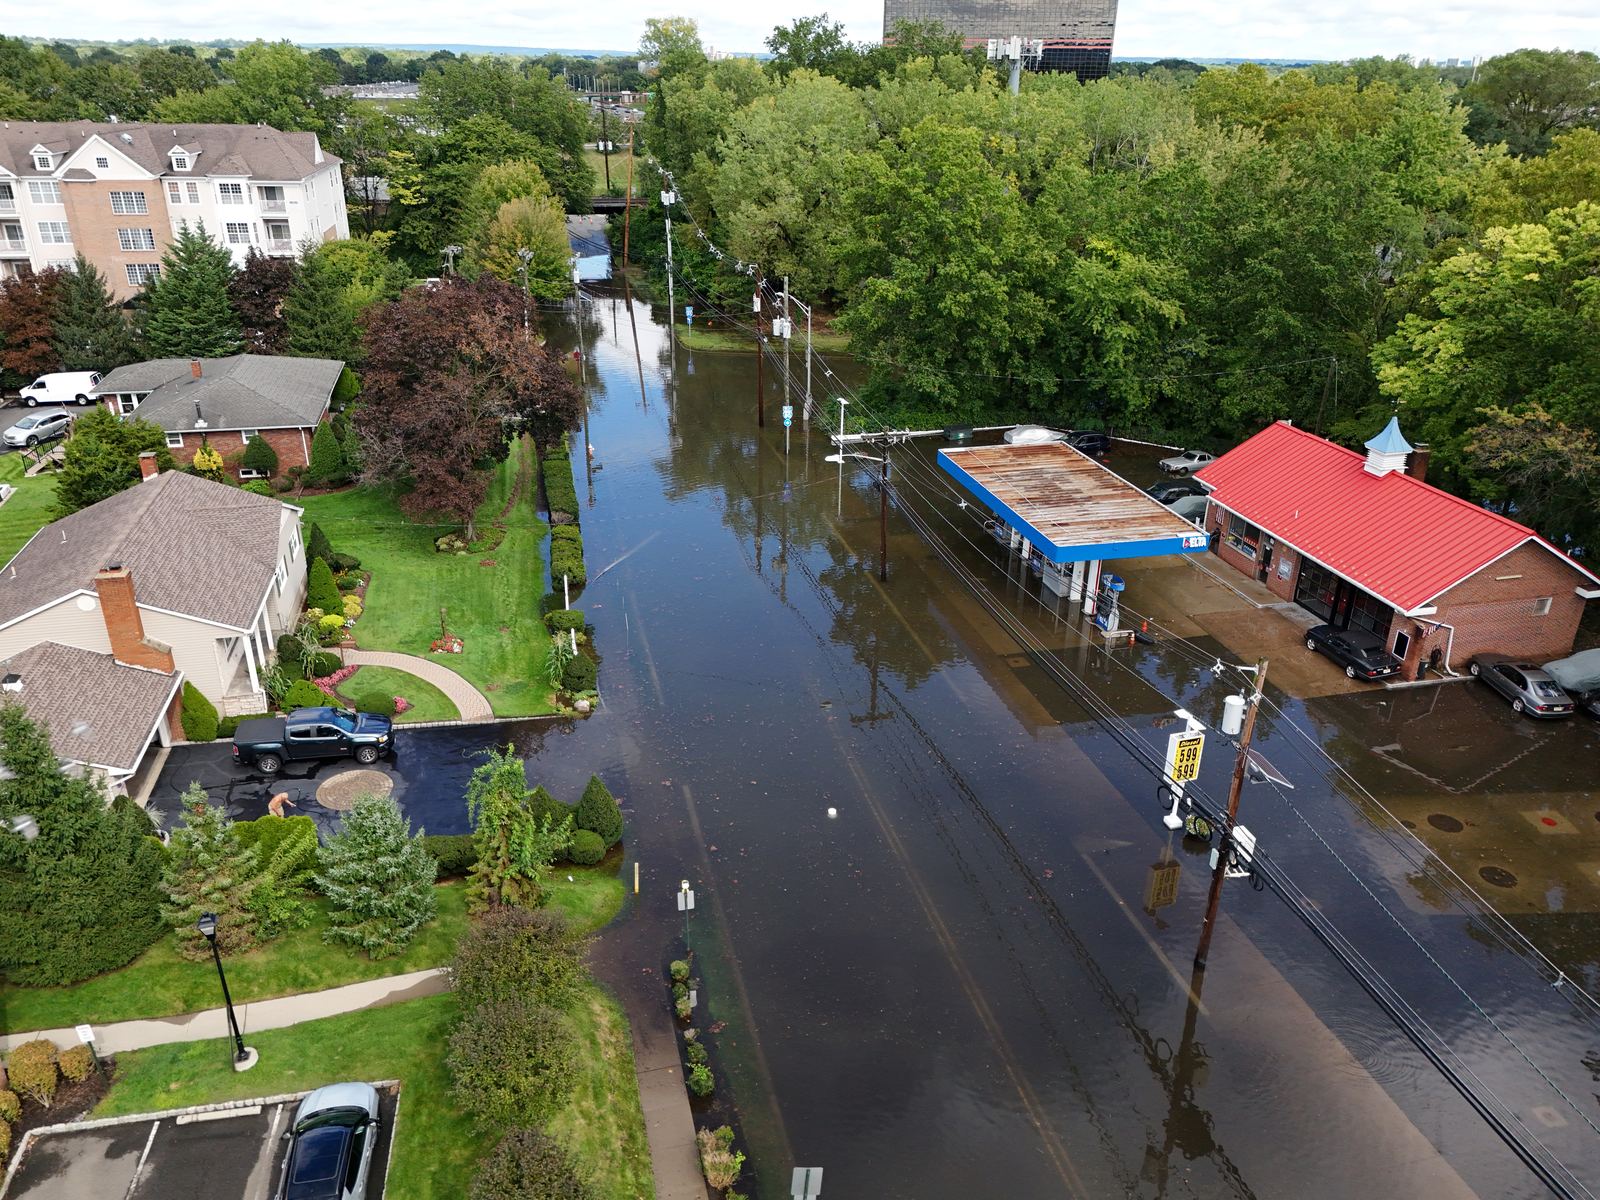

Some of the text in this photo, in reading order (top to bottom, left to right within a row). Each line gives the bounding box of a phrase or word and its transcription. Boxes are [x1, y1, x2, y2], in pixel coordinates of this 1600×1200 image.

[1183, 536, 1207, 548] DELTA
[1180, 747, 1198, 763] 599
[1177, 763, 1195, 779] 599
